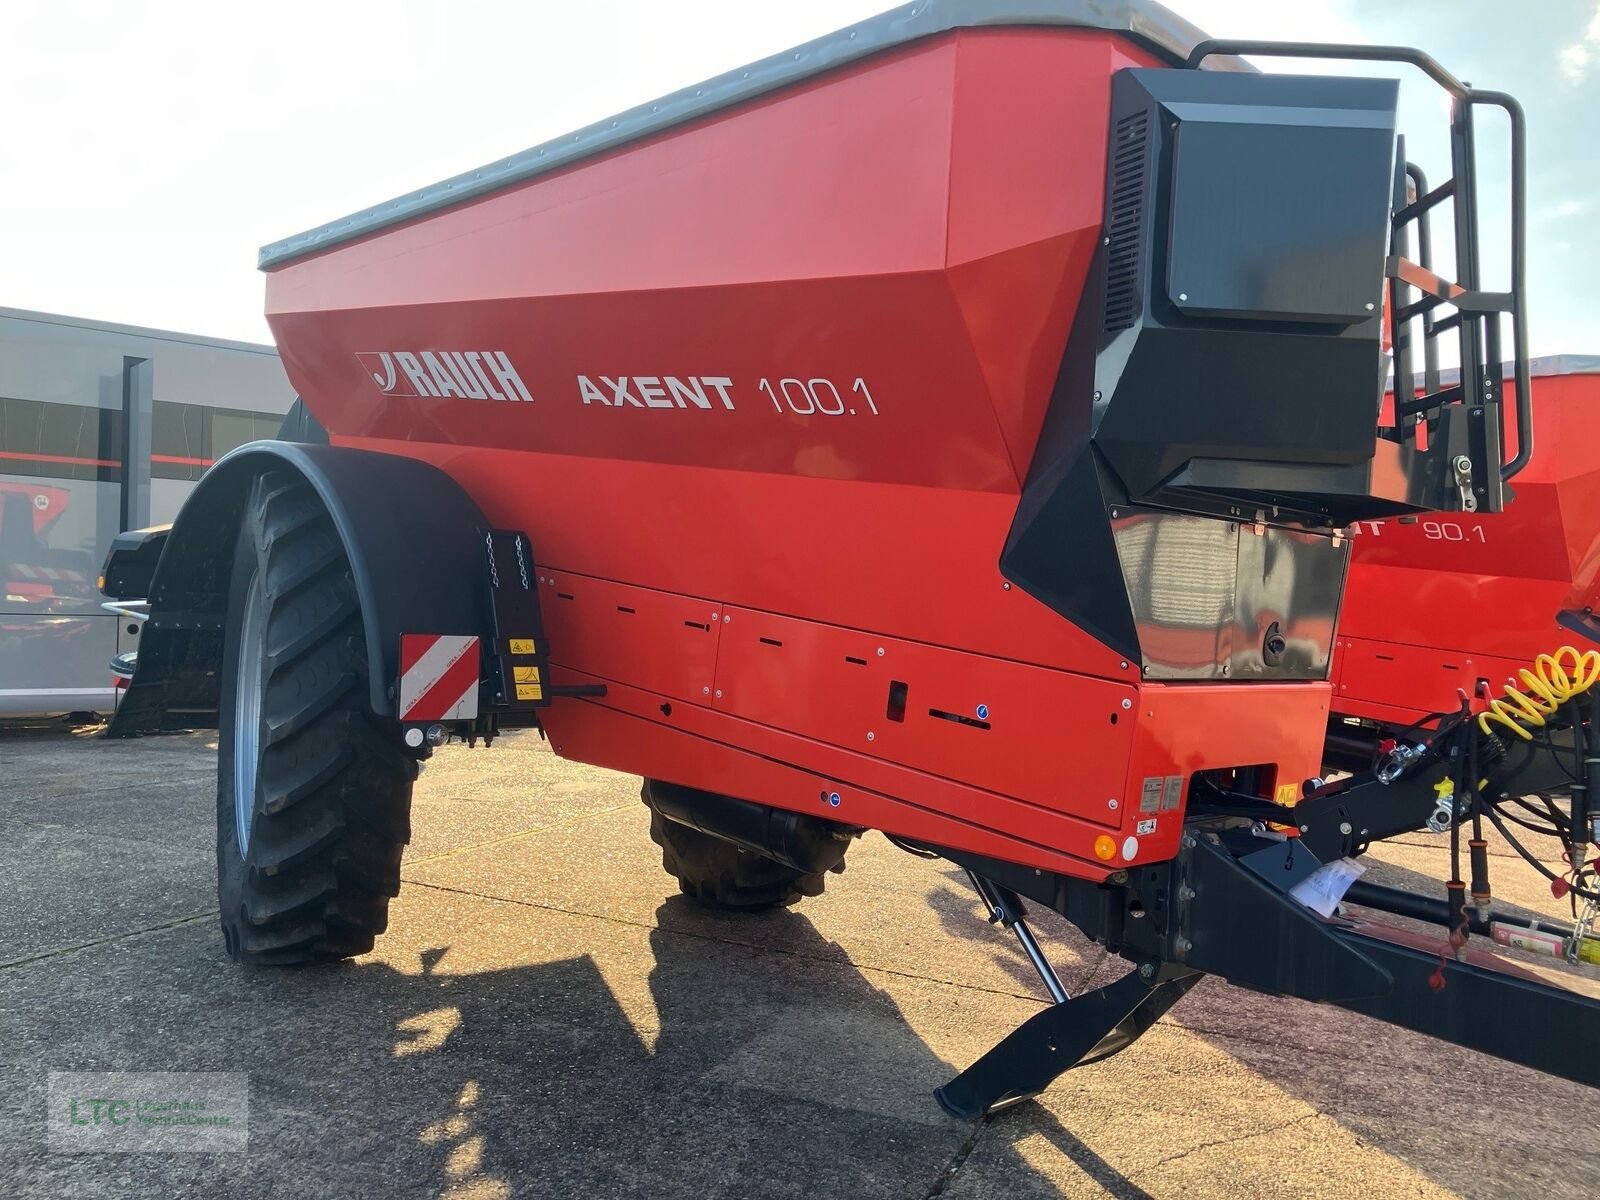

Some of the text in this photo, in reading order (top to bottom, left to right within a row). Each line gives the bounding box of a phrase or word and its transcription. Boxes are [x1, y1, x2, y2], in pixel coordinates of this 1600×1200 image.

[393, 351, 534, 401] RAUCH
[577, 375, 879, 415] AXENT 100.1
[1423, 522, 1486, 543] 90.1
